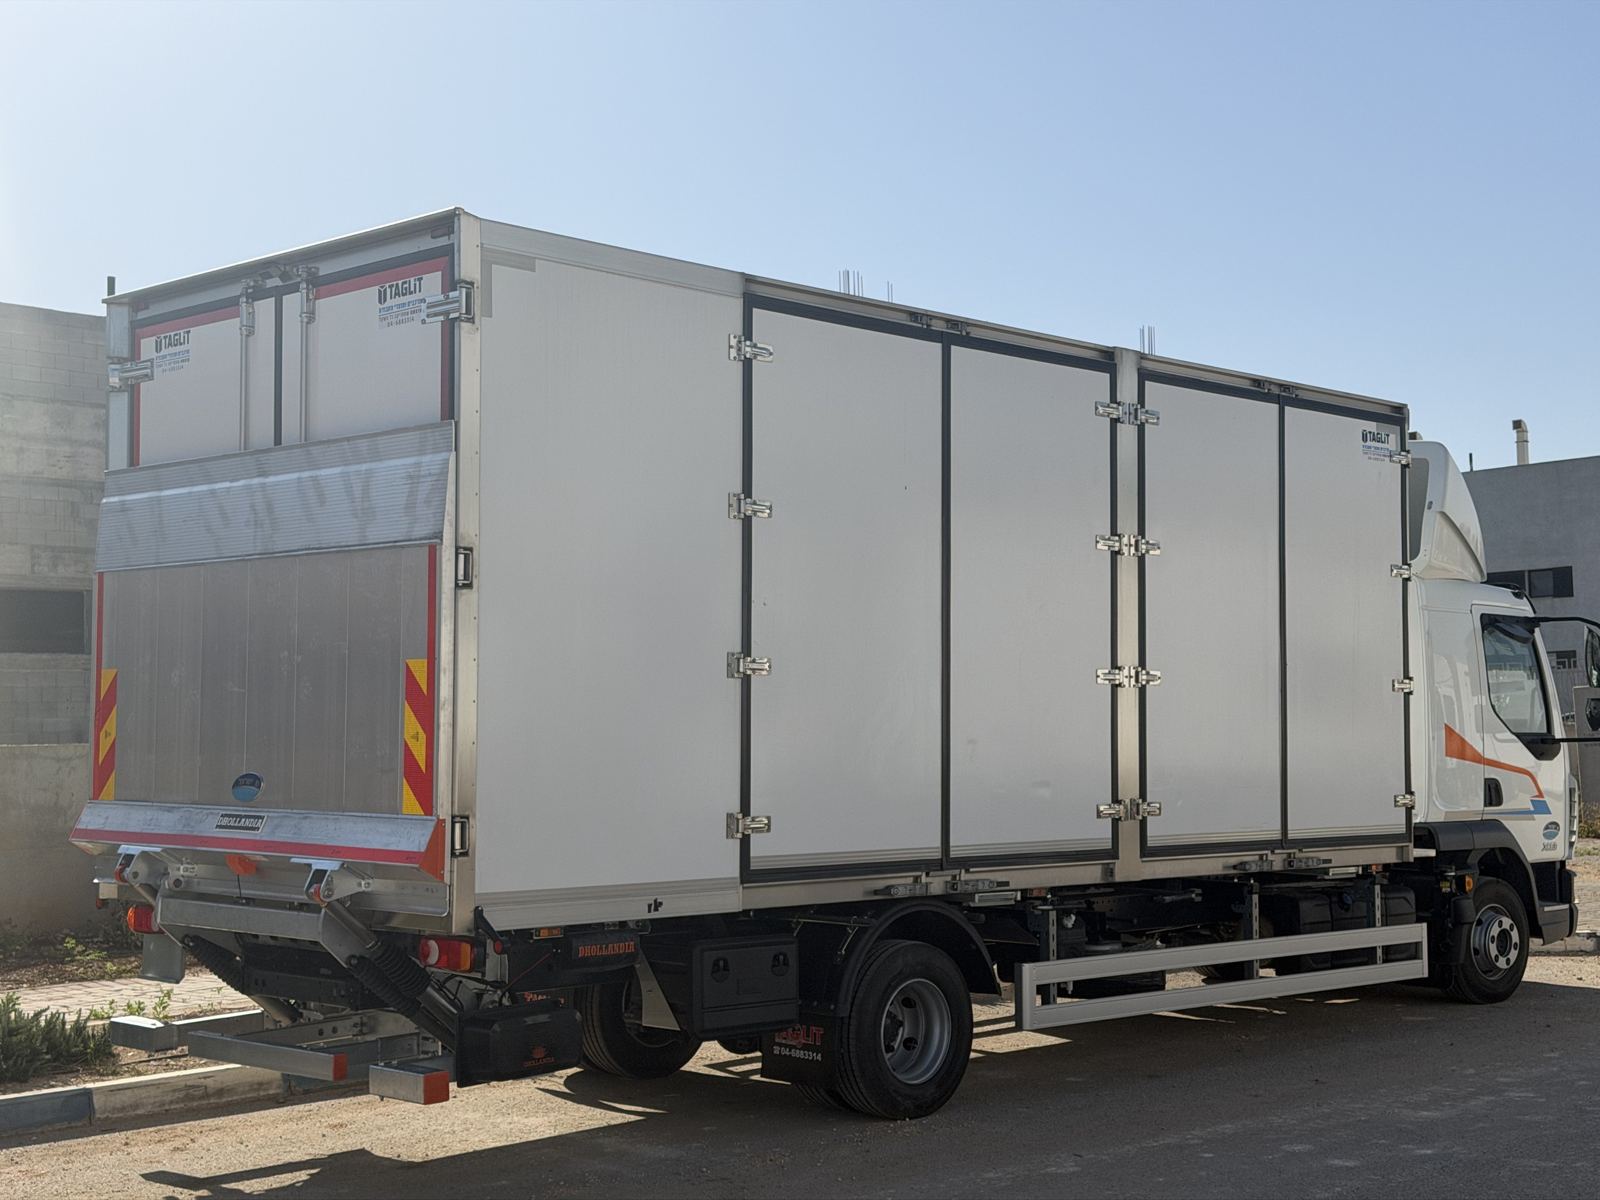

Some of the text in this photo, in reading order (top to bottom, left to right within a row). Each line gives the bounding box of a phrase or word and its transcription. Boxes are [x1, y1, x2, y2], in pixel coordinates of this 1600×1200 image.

[217, 816, 262, 828] DHOLLANDIA
[578, 941, 635, 958] DHOLLANDIA
[781, 1047, 822, 1062] 04-6883314
